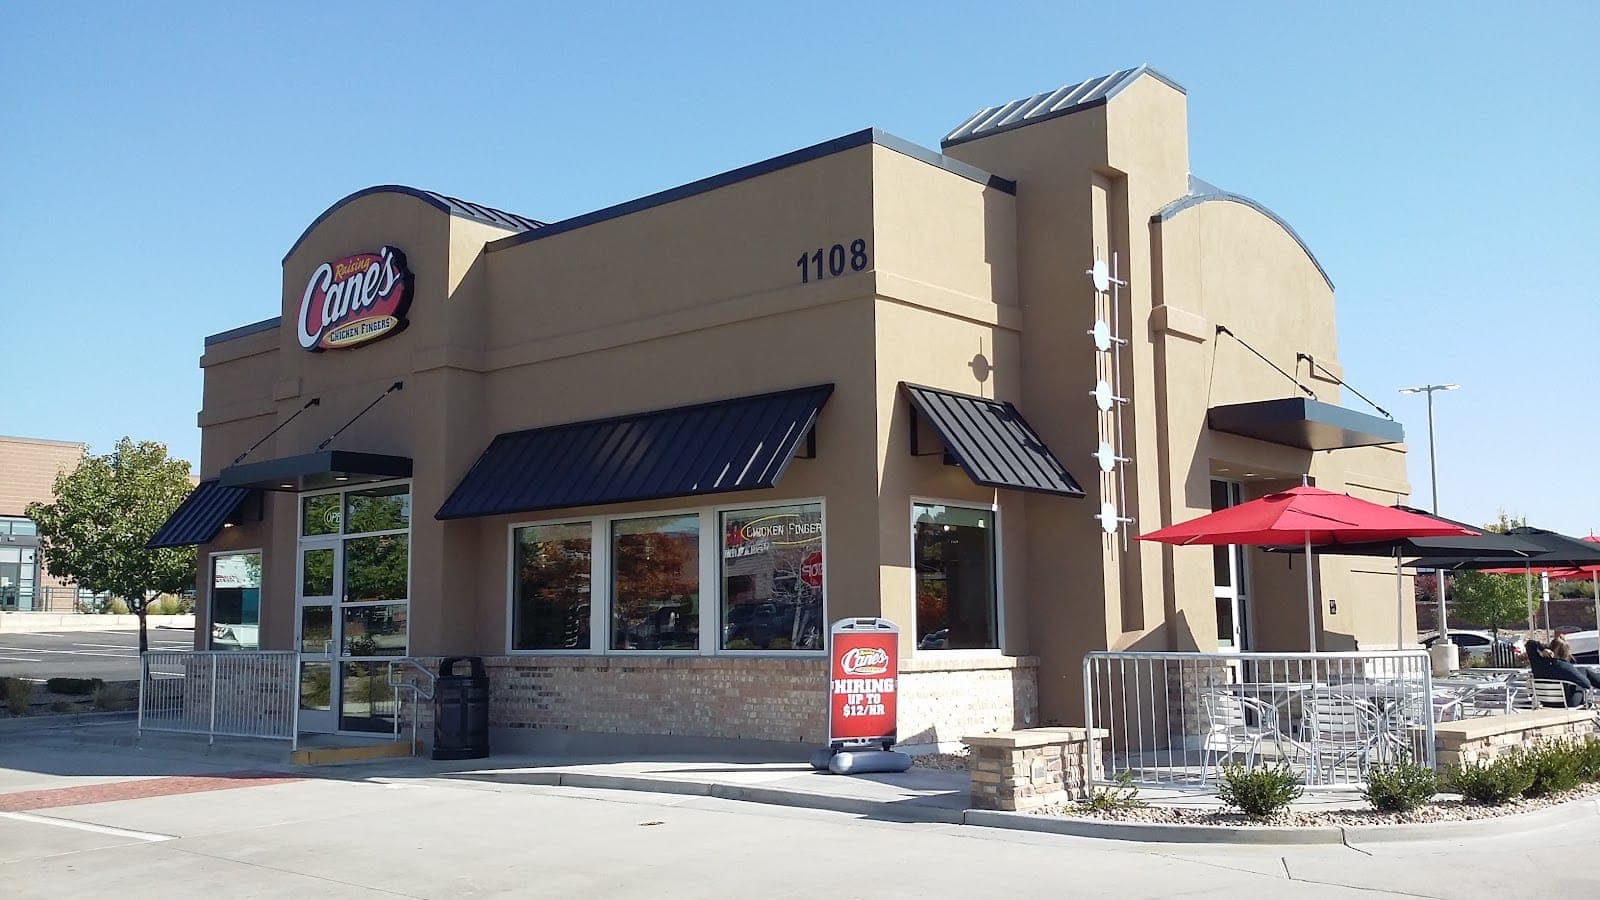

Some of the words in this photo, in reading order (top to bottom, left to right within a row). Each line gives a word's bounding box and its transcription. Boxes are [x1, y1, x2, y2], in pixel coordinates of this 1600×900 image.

[335, 257, 371, 281] Raising
[797, 239, 867, 283] 1108
[298, 246, 400, 347] Cane's
[330, 327, 359, 342] CHICKEN
[361, 318, 390, 335] FINGERS
[834, 679, 894, 694] HIRING
[843, 704, 885, 718] $12/HR
[848, 694, 863, 705] UP
[866, 694, 881, 705] TO
